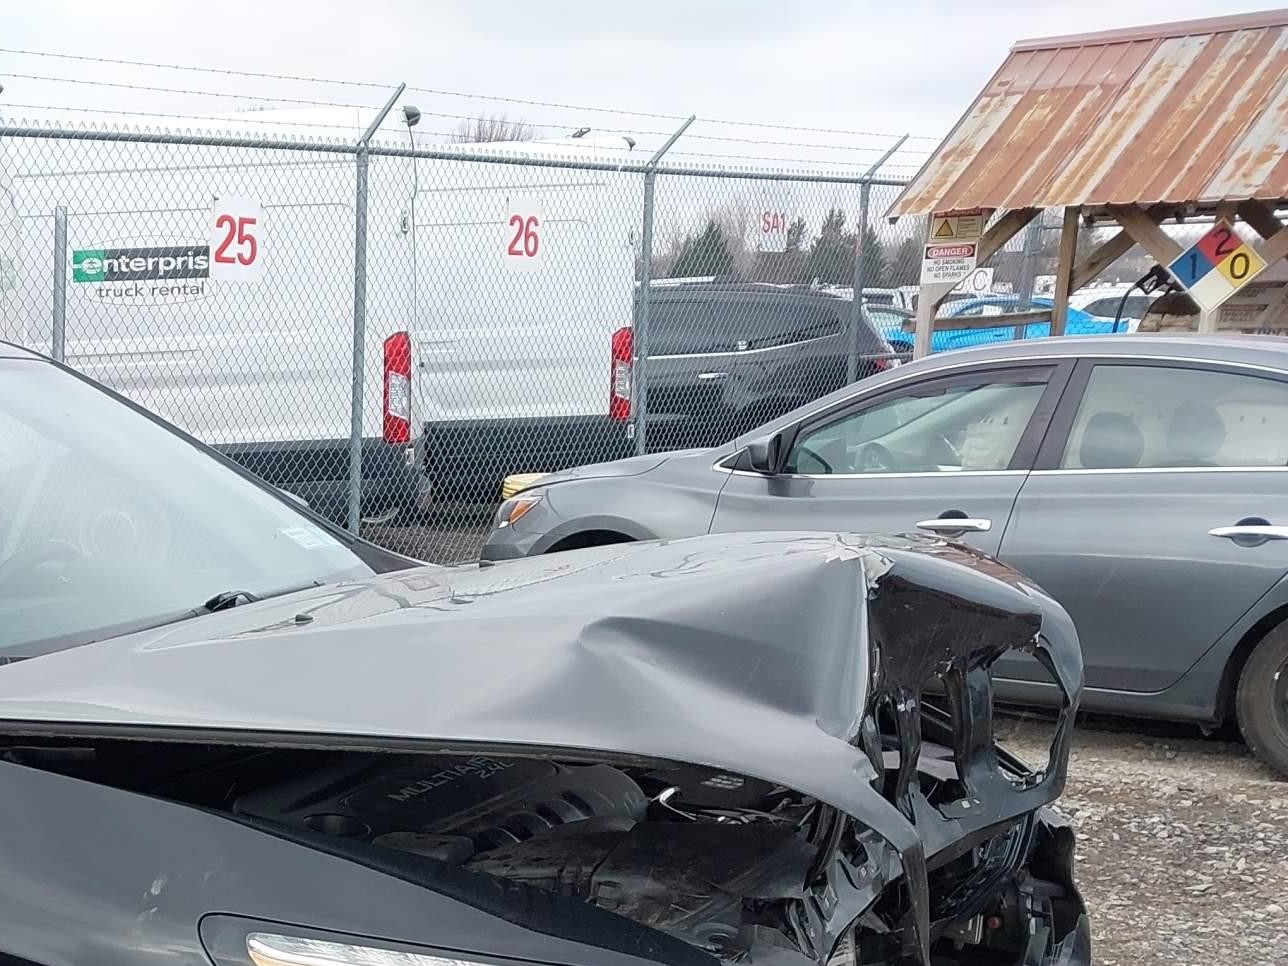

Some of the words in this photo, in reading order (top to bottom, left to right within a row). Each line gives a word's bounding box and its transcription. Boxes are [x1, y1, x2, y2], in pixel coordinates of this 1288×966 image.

[508, 214, 539, 257] 26
[762, 211, 786, 234] SA1
[214, 214, 258, 266] 25
[932, 247, 968, 257] DANGER
[1213, 228, 1235, 256] 2
[1189, 253, 1198, 279] 1
[1230, 252, 1250, 279] 0
[97, 283, 144, 298] truck
[150, 281, 205, 297] rental
[475, 761, 516, 779] 2.4L
